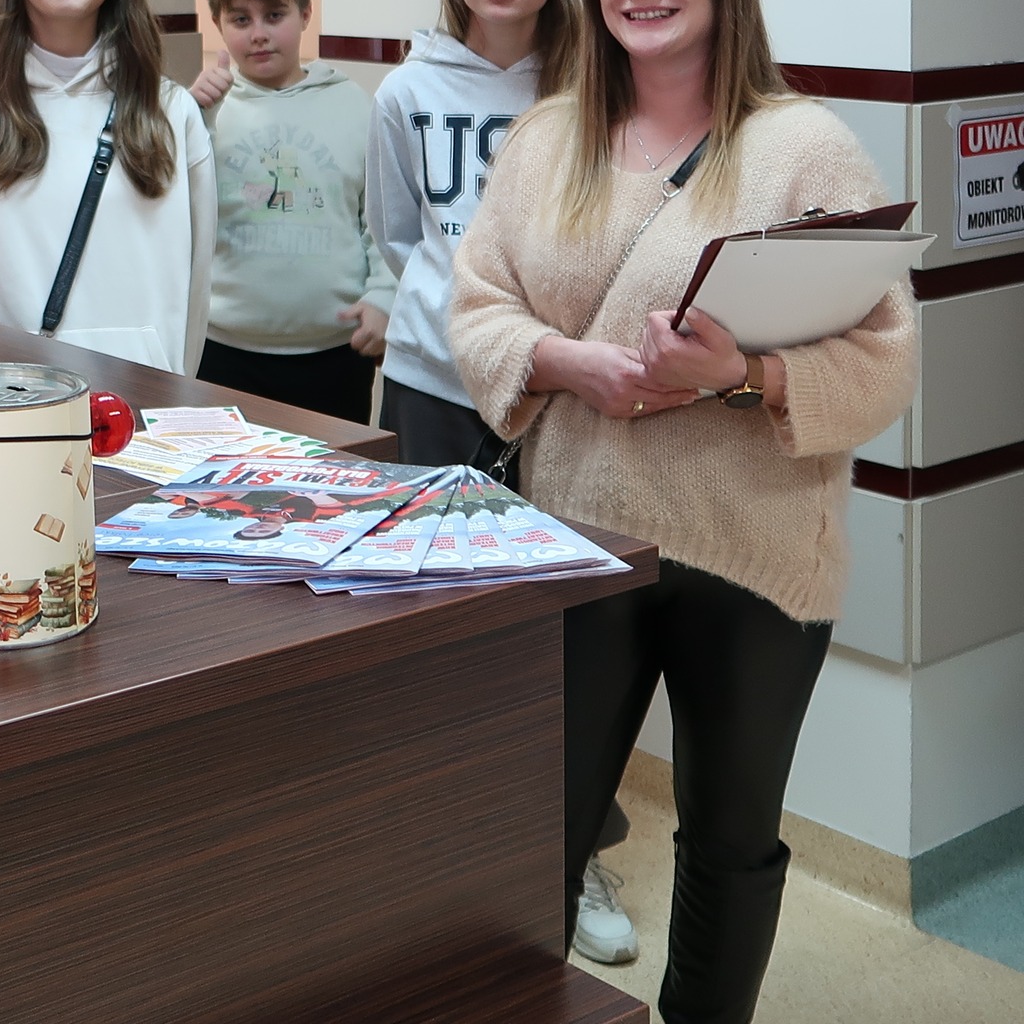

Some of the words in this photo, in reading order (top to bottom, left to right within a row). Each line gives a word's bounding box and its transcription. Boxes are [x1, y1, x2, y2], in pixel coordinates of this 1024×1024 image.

[967, 176, 1004, 197] OBIEKT
[440, 222, 466, 236] NE
[187, 470, 283, 486] SIŁY
